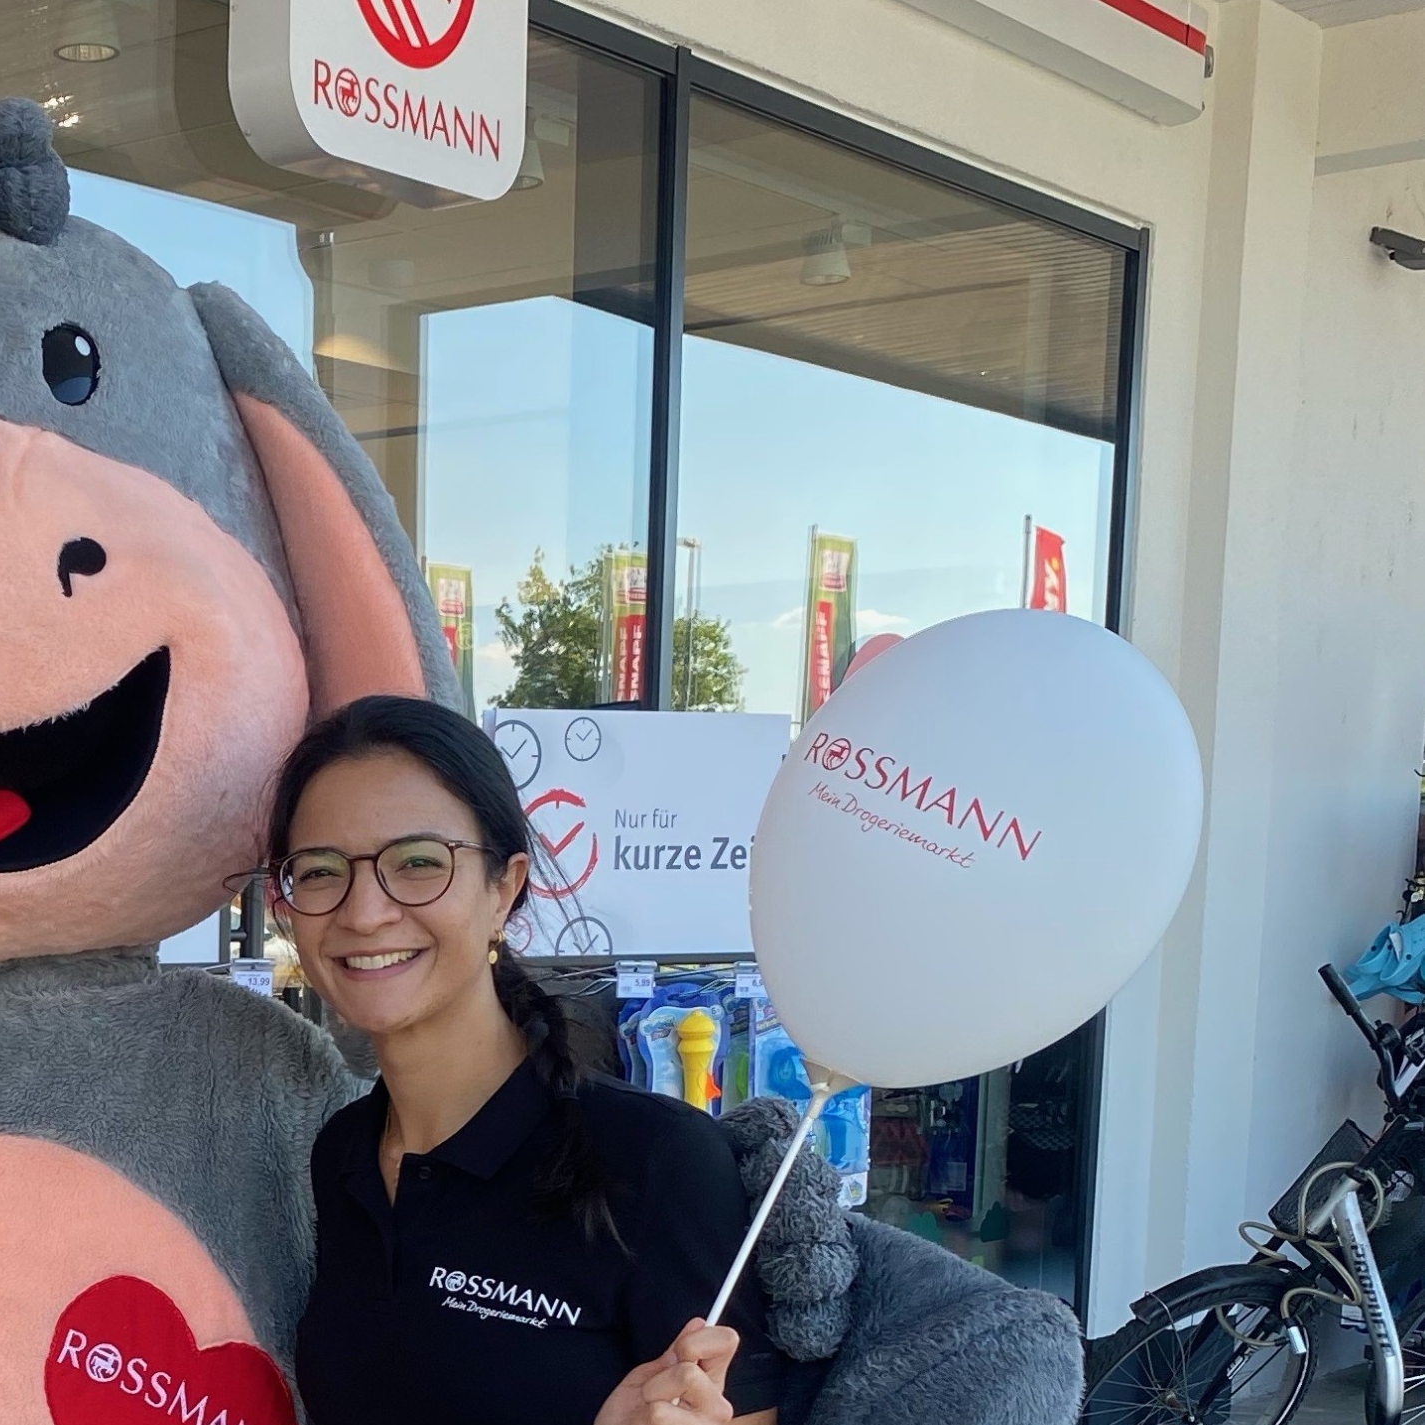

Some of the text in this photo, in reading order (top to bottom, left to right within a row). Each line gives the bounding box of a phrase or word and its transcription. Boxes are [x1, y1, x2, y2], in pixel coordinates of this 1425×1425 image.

[313, 58, 501, 163] ROSSMANN
[614, 807, 678, 829] Nur für
[803, 732, 1042, 861] ROSSMANN
[808, 780, 977, 869] Mein Drogeriemarkt
[613, 835, 702, 871] kurze
[429, 1266, 582, 1326] ROSSMANN
[441, 1295, 549, 1329] Mein Drogeriemarkt
